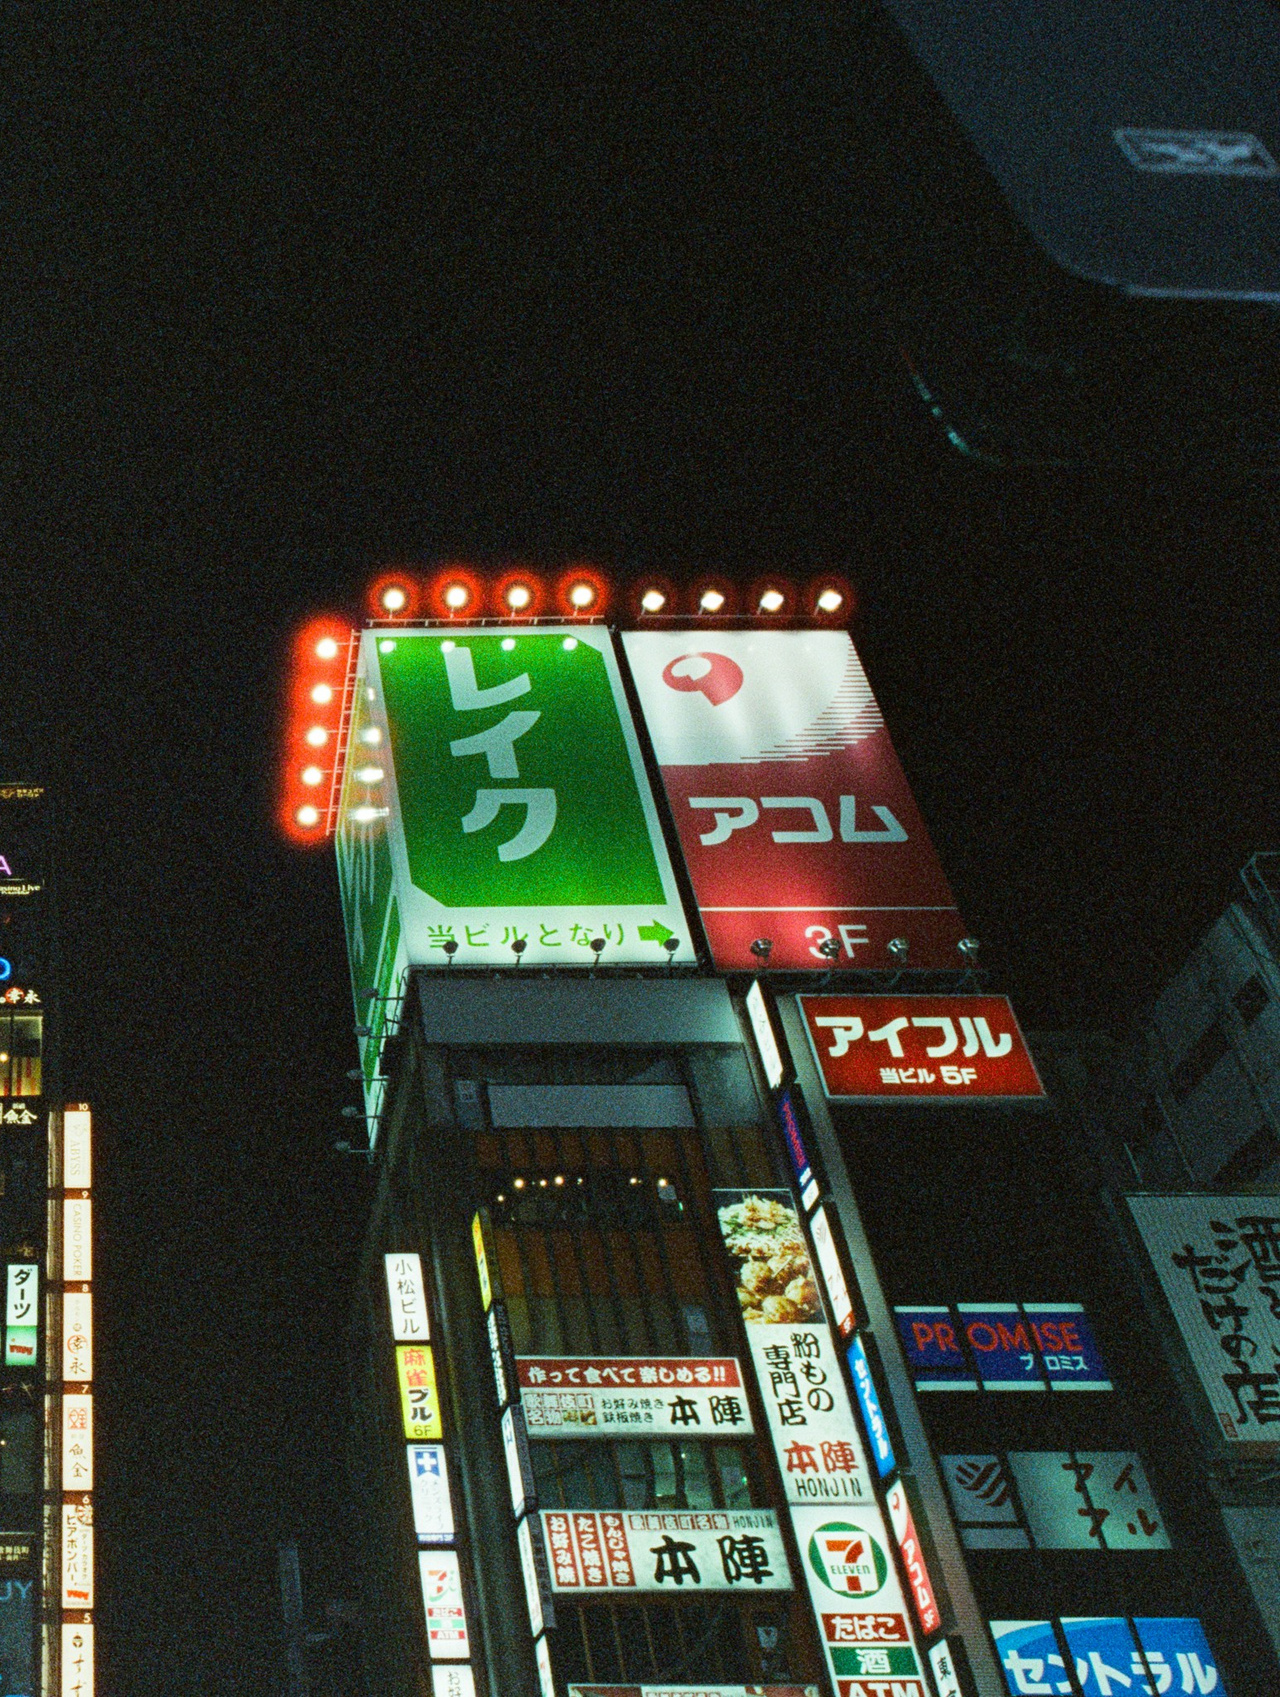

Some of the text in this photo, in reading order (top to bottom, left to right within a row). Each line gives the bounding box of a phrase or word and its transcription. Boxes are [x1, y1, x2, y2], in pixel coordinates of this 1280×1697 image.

[442, 647, 558, 862] レイク
[688, 795, 909, 846] アコム
[427, 922, 625, 948] 当ビルとなり
[804, 924, 869, 959] 3F
[815, 1016, 1013, 1058] アイフル
[879, 1065, 978, 1085] 当ビル 5F
[78, 1103, 89, 1111] 10
[81, 1190, 88, 1199] 9
[14, 1269, 33, 1320] ダーツ
[81, 1284, 89, 1293] 8
[395, 1259, 420, 1335] 小松ビル
[911, 1322, 1084, 1352] PROMISE
[762, 1344, 808, 1426] 専門店
[790, 1332, 834, 1412] 粉もの
[601, 1397, 665, 1411] お好み焼き
[667, 1395, 746, 1427] 本陣
[413, 1425, 433, 1437] 6F
[783, 1440, 860, 1475] 本陣
[82, 1494, 90, 1504] 6
[795, 1477, 863, 1498] HONJIN
[732, 1515, 773, 1529] HONJIN
[650, 1534, 774, 1585] 本陣
[83, 1612, 91, 1623] 5
[831, 1615, 901, 1640] たばこ
[855, 1649, 892, 1675] 酒
[1003, 1650, 1218, 1697] セントラル
